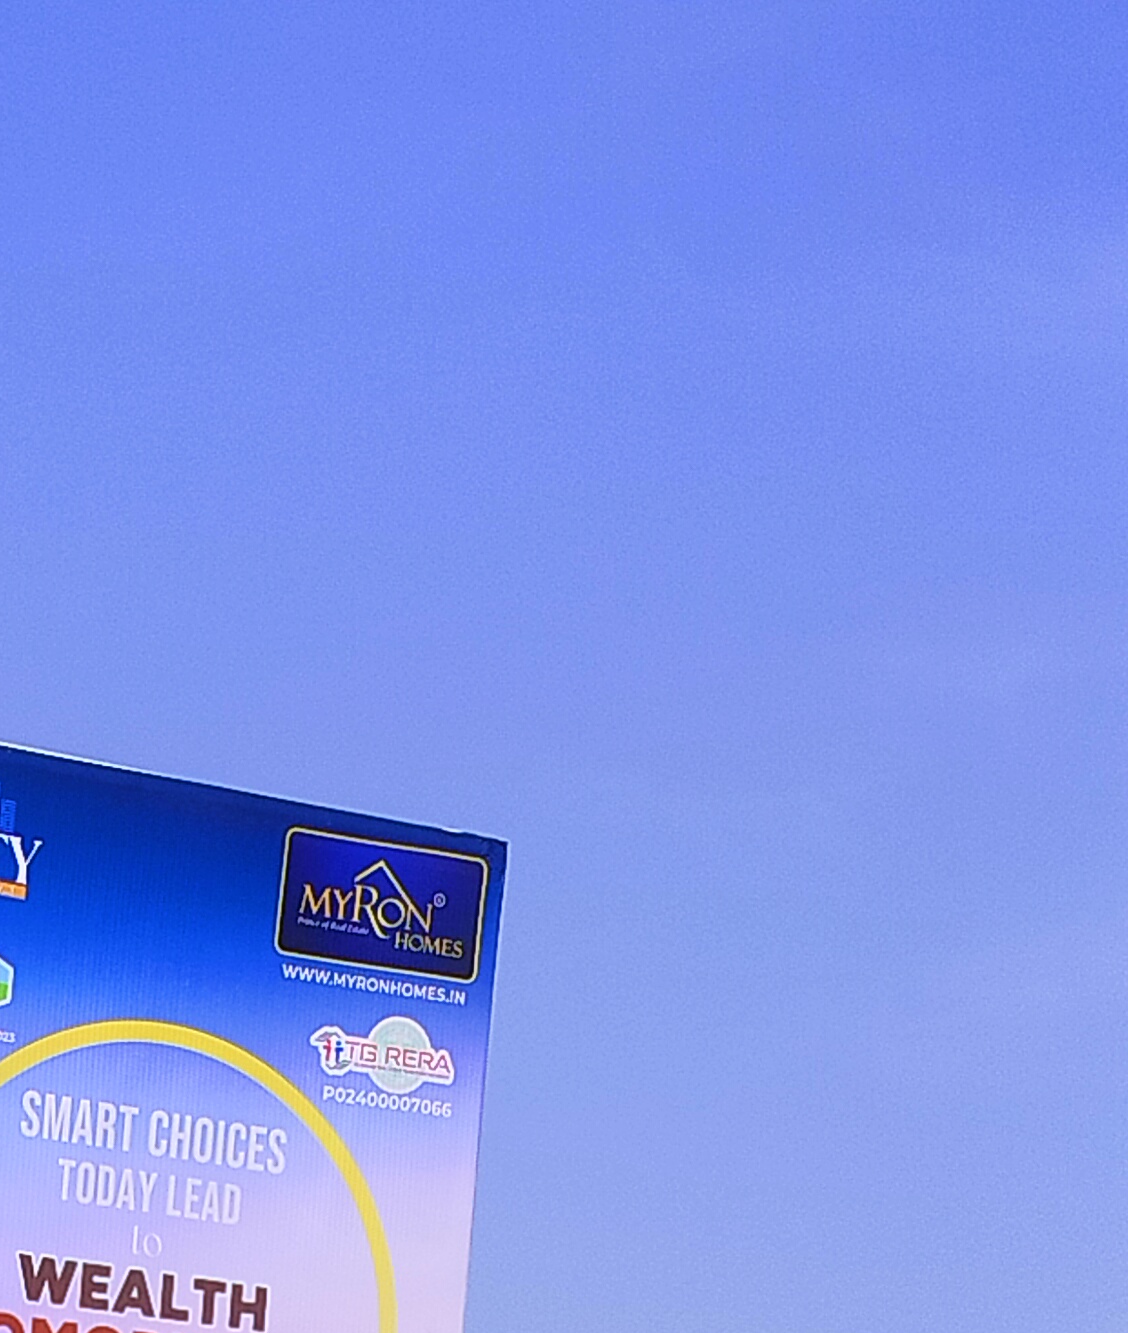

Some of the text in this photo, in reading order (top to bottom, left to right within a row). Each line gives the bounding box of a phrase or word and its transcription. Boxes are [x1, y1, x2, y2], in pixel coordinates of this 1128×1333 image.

[395, 932, 463, 958] HOMES
[282, 963, 466, 1006] WWW.MYRONHOMES.IN
[345, 1040, 378, 1063] TG
[385, 1046, 450, 1074] RERA
[323, 1085, 452, 1117] P02400007066
[20, 1090, 288, 1174] SMART CHOICES
[58, 1158, 242, 1225] TODAY LEAD
[131, 1225, 162, 1258] to
[18, 1253, 269, 1332] WEALTH
